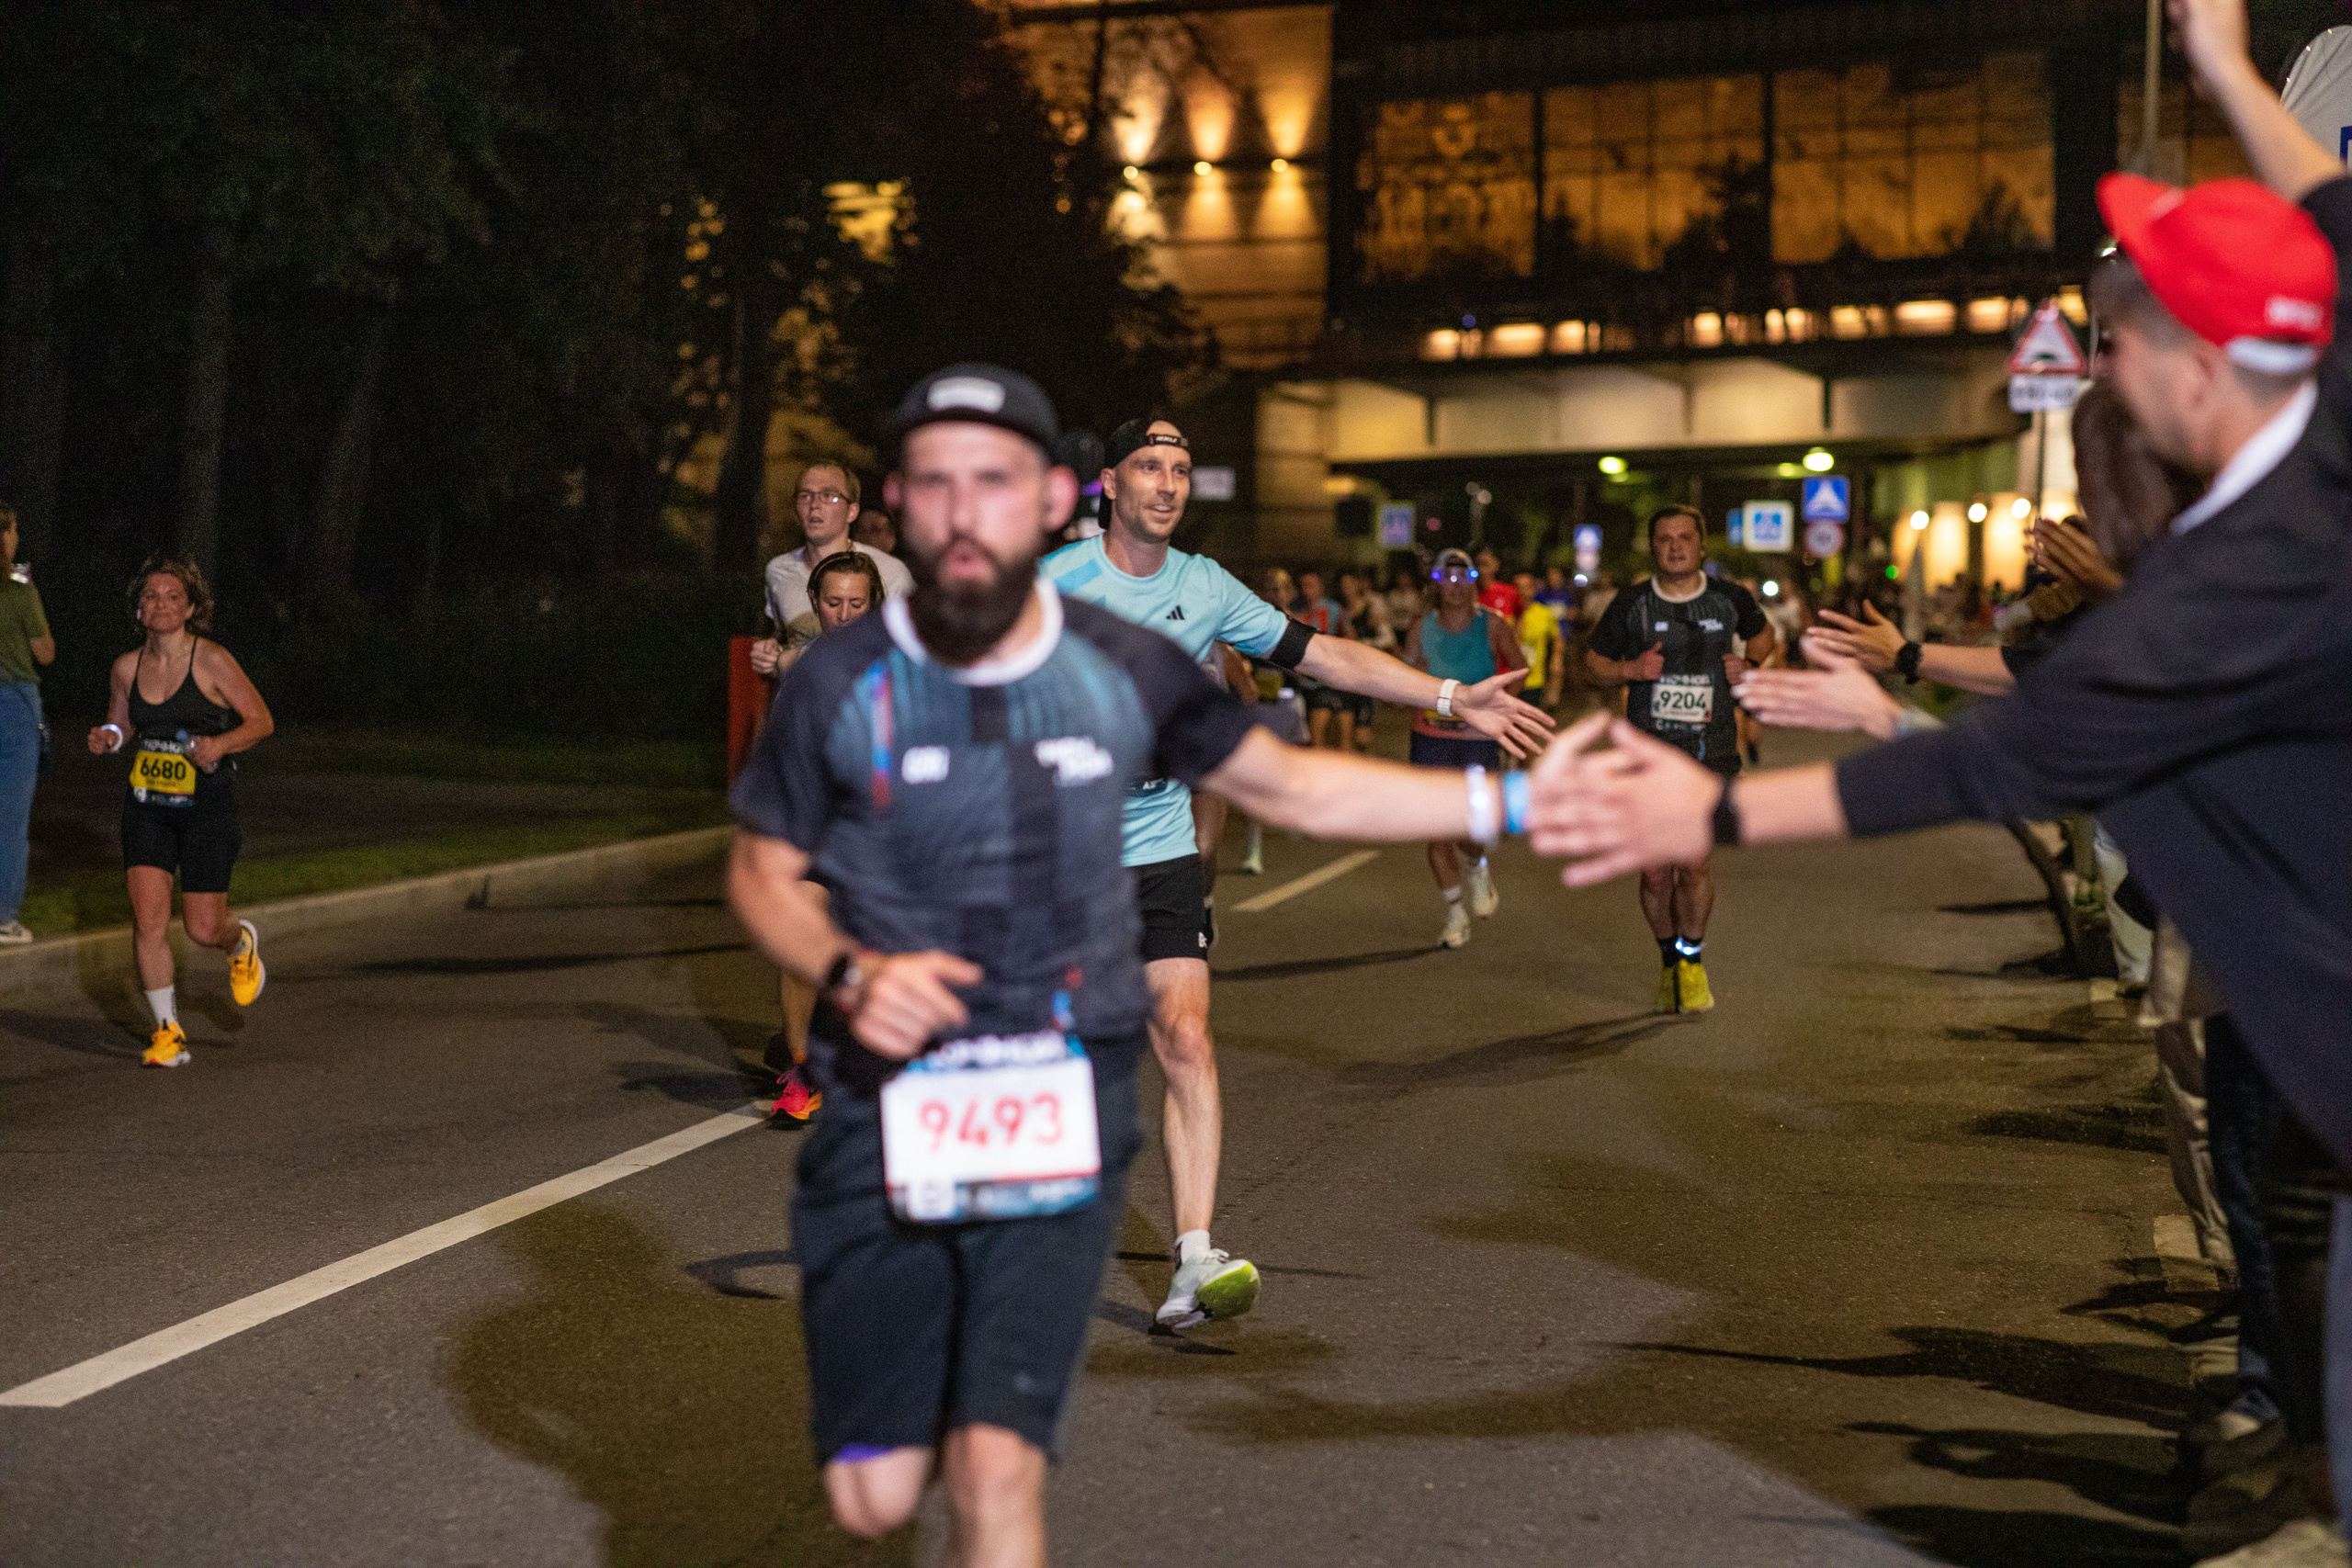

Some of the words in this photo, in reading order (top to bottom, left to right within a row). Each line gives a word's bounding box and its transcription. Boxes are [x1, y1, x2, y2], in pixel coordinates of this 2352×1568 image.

[1660, 690, 1706, 709] 9204
[140, 757, 187, 781] 6680
[919, 1091, 1064, 1154] 9493
